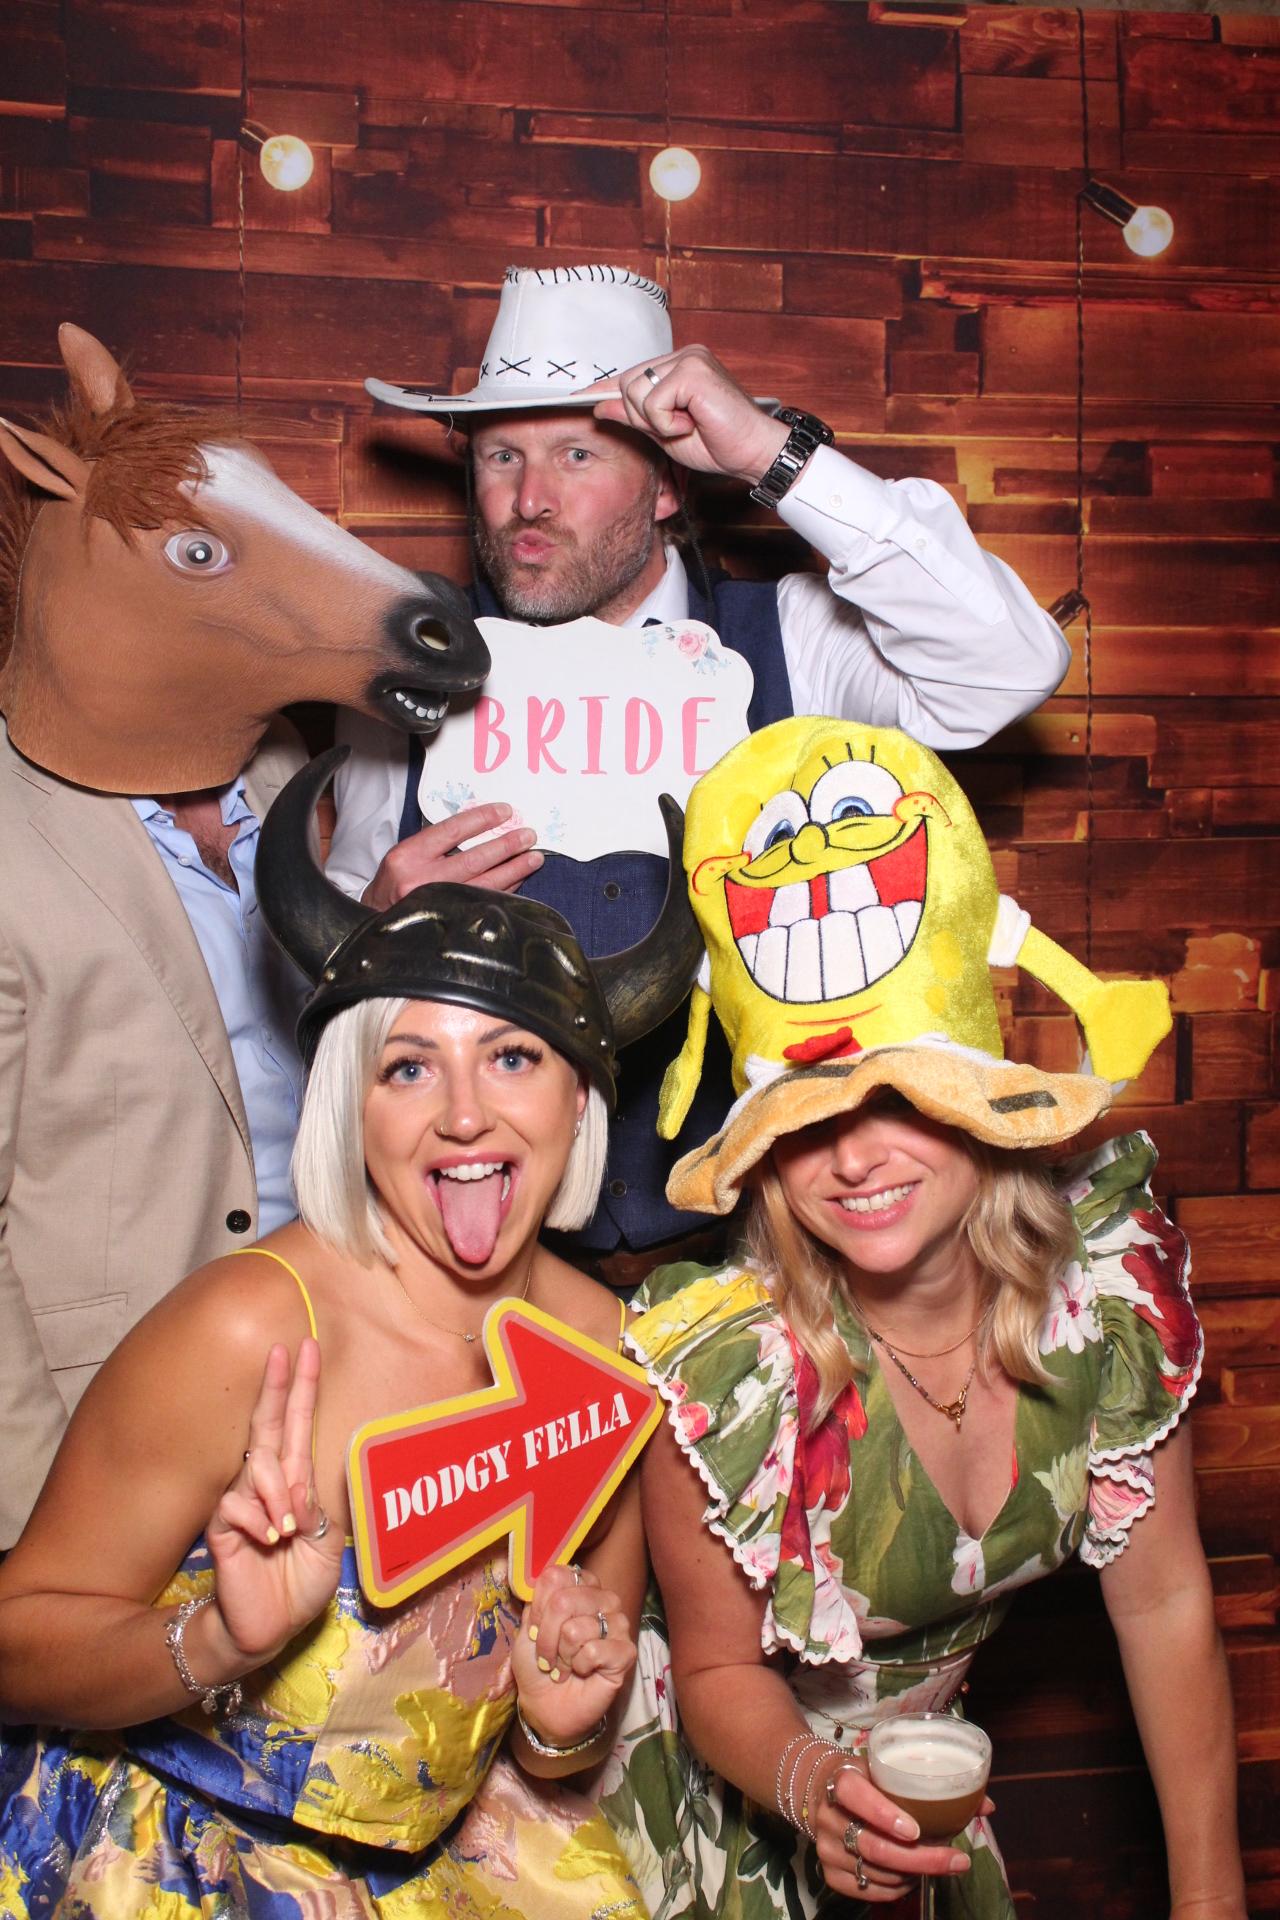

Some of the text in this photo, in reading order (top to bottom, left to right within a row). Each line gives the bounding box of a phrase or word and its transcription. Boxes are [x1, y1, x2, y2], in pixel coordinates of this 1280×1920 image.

[473, 695, 716, 776] BRIDE
[382, 1392, 631, 1531] DODGY FELLA
